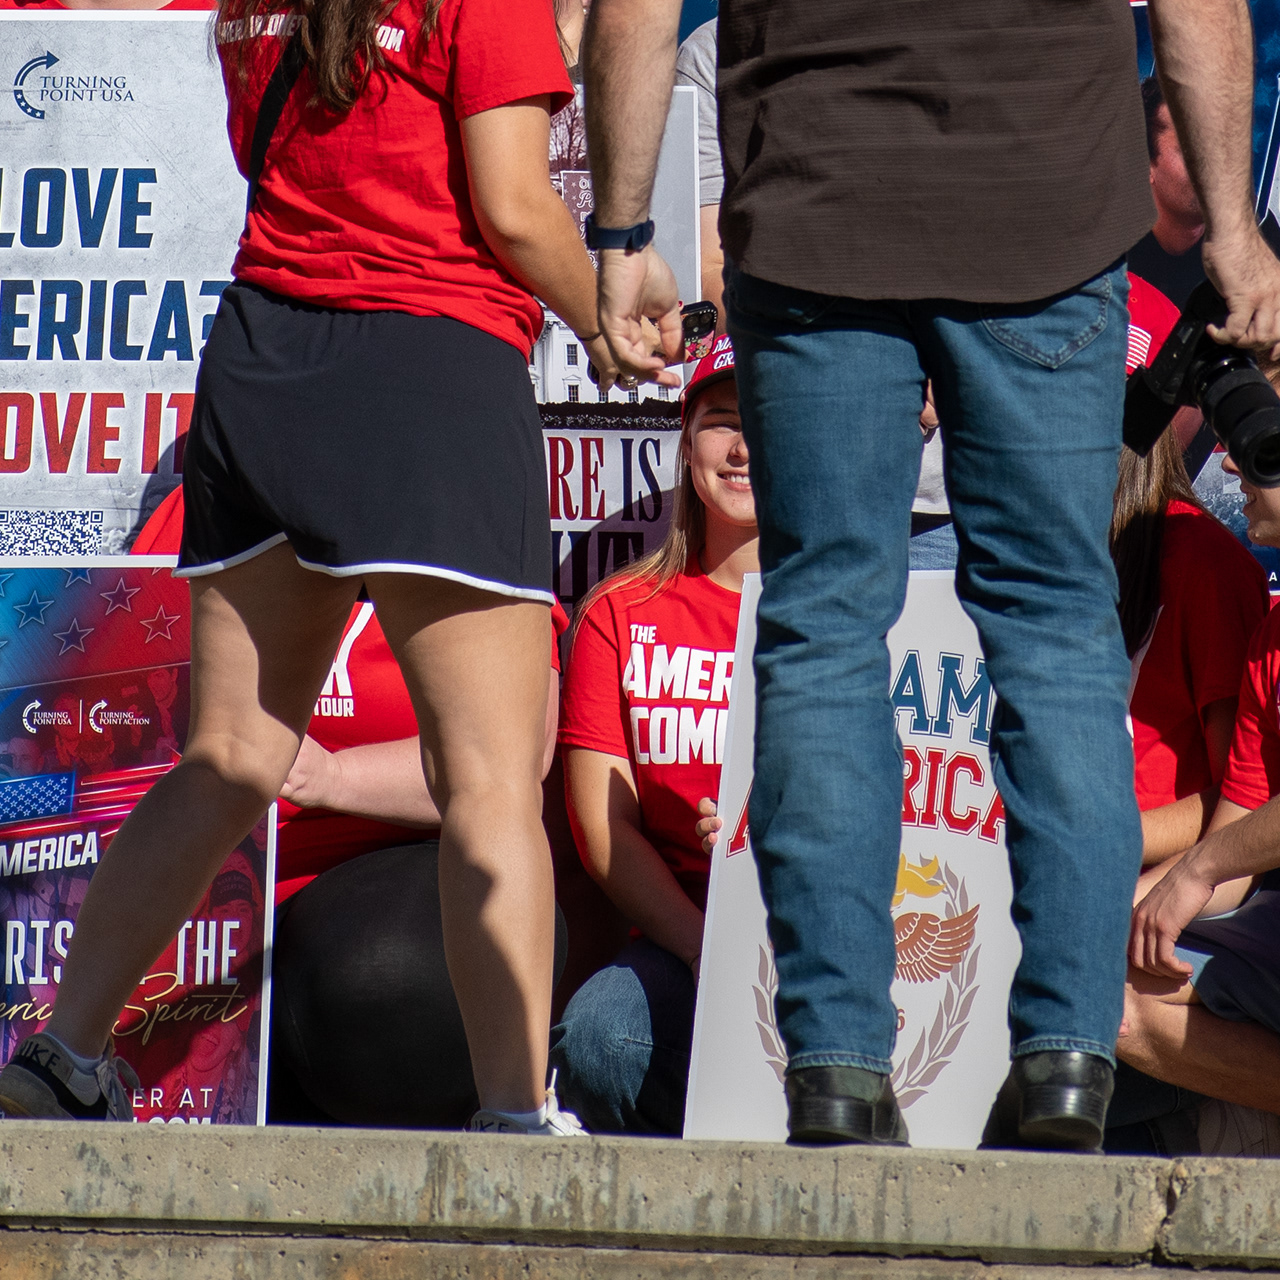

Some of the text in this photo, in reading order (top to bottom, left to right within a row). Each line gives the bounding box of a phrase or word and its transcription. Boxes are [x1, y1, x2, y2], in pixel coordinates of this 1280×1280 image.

[40, 75, 127, 89] TURNING
[40, 89, 135, 102] POINT USA
[620, 437, 663, 523] IS
[629, 624, 656, 644] THE
[33, 711, 68, 719] TURNING
[99, 711, 134, 719] TURNING
[176, 920, 240, 985] THE
[112, 973, 247, 1046] Spirit
[179, 1088, 213, 1108] AT
